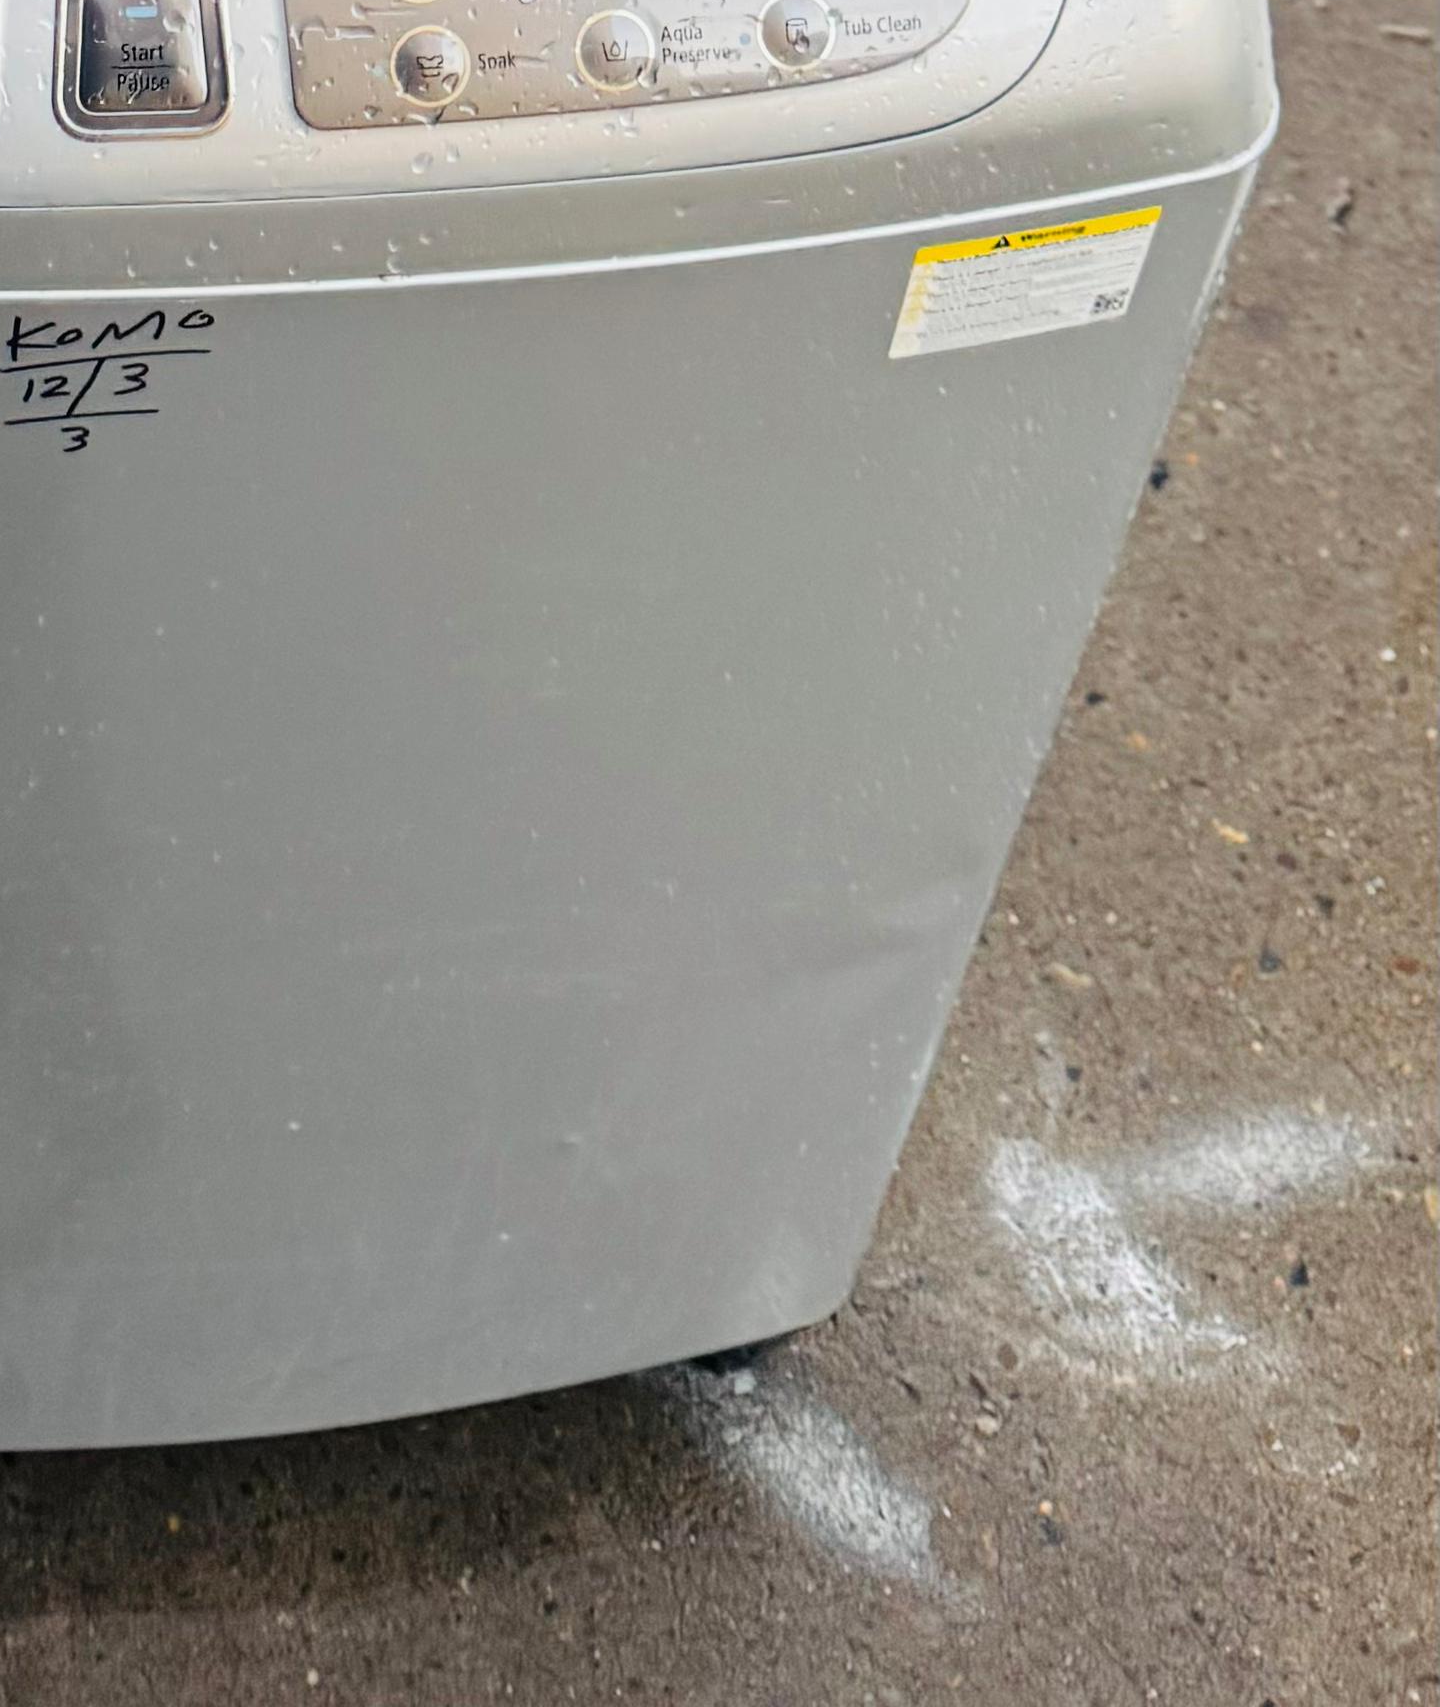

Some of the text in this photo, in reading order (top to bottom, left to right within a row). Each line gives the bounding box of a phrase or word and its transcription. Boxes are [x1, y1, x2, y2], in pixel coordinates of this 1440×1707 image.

[878, 15, 923, 34] Clean
[660, 25, 704, 45] Aqua
[121, 43, 164, 62] Start
[117, 72, 170, 95] Pause
[60, 425, 90, 453] 3
